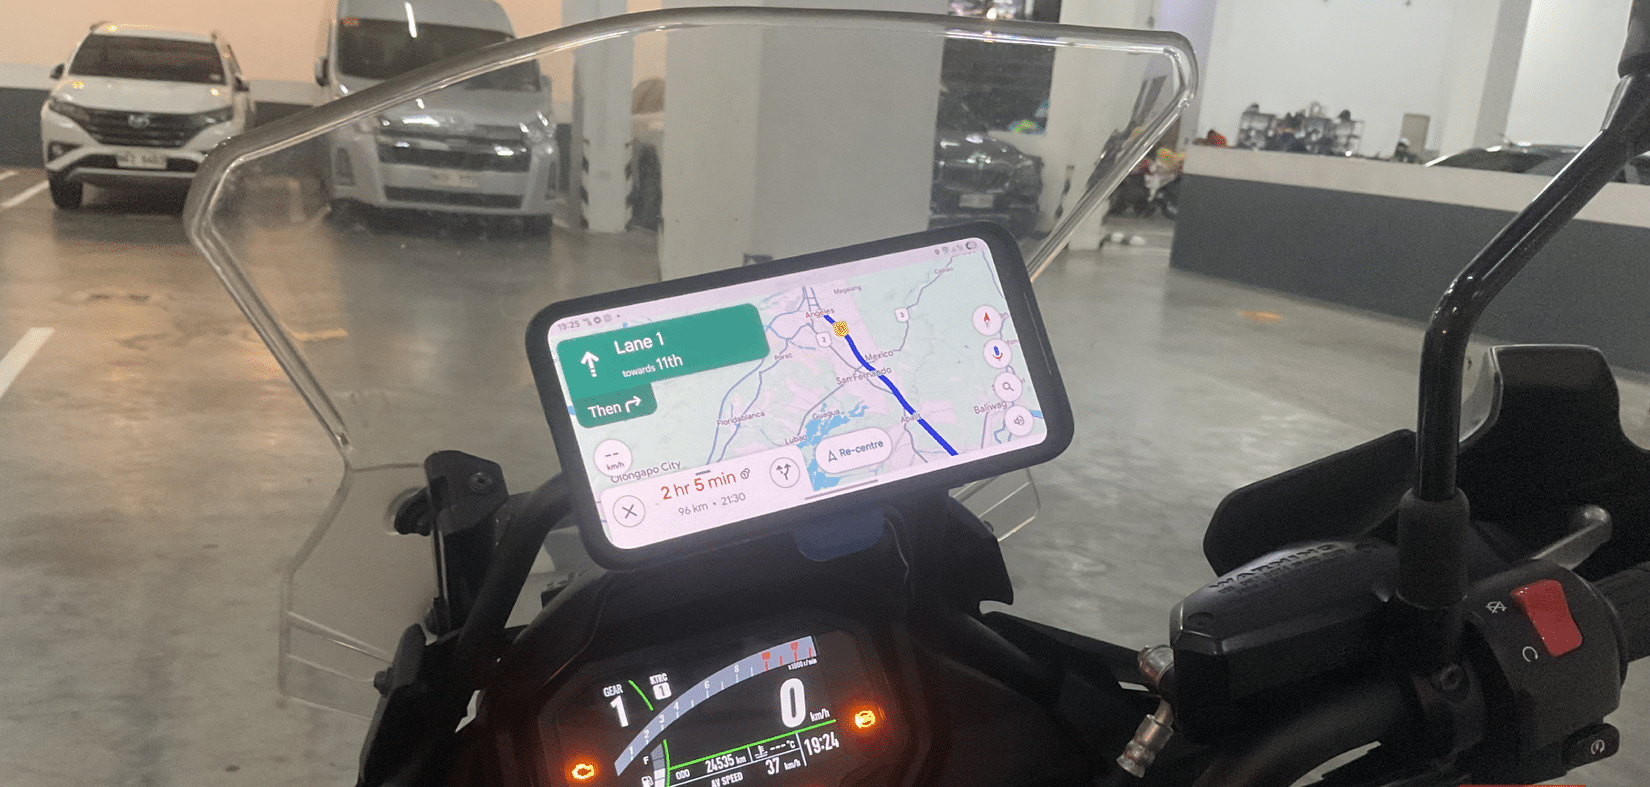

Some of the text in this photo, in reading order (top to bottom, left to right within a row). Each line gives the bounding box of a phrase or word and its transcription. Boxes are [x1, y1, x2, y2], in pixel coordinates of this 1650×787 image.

[805, 308, 835, 318] Angeles
[557, 320, 580, 331] 19:25
[613, 332, 665, 355] Lane 1
[864, 350, 894, 361] Mexico
[622, 353, 683, 378] towards 11th
[836, 366, 892, 385] San Fernando
[588, 402, 622, 418] Then
[812, 409, 841, 420] Guagua
[973, 401, 1008, 415] Baliwag
[716, 410, 765, 427] Floridablanca
[784, 434, 808, 445] Lubao
[839, 440, 884, 457] Re-centre
[606, 461, 625, 471] km/h
[610, 461, 681, 484] Olongapo City
[661, 472, 737, 500] 2 hr 5 min
[678, 492, 746, 517] 96 km 21:30
[734, 665, 739, 673] 8
[649, 673, 668, 685] KTRC
[704, 680, 710, 689] 6
[603, 684, 624, 697] GEAR
[659, 686, 665, 697] 1
[673, 702, 679, 710] 4
[780, 677, 806, 728] 0
[610, 695, 629, 727] 1
[809, 708, 830, 722] km/h
[659, 714, 665, 723] 3
[644, 730, 650, 738] 2
[803, 731, 840, 756] 19:24
[643, 756, 649, 765] F
[705, 754, 735, 773] 24535
[735, 756, 747, 764] km
[711, 757, 801, 787] AV SPEED 37 km/h
